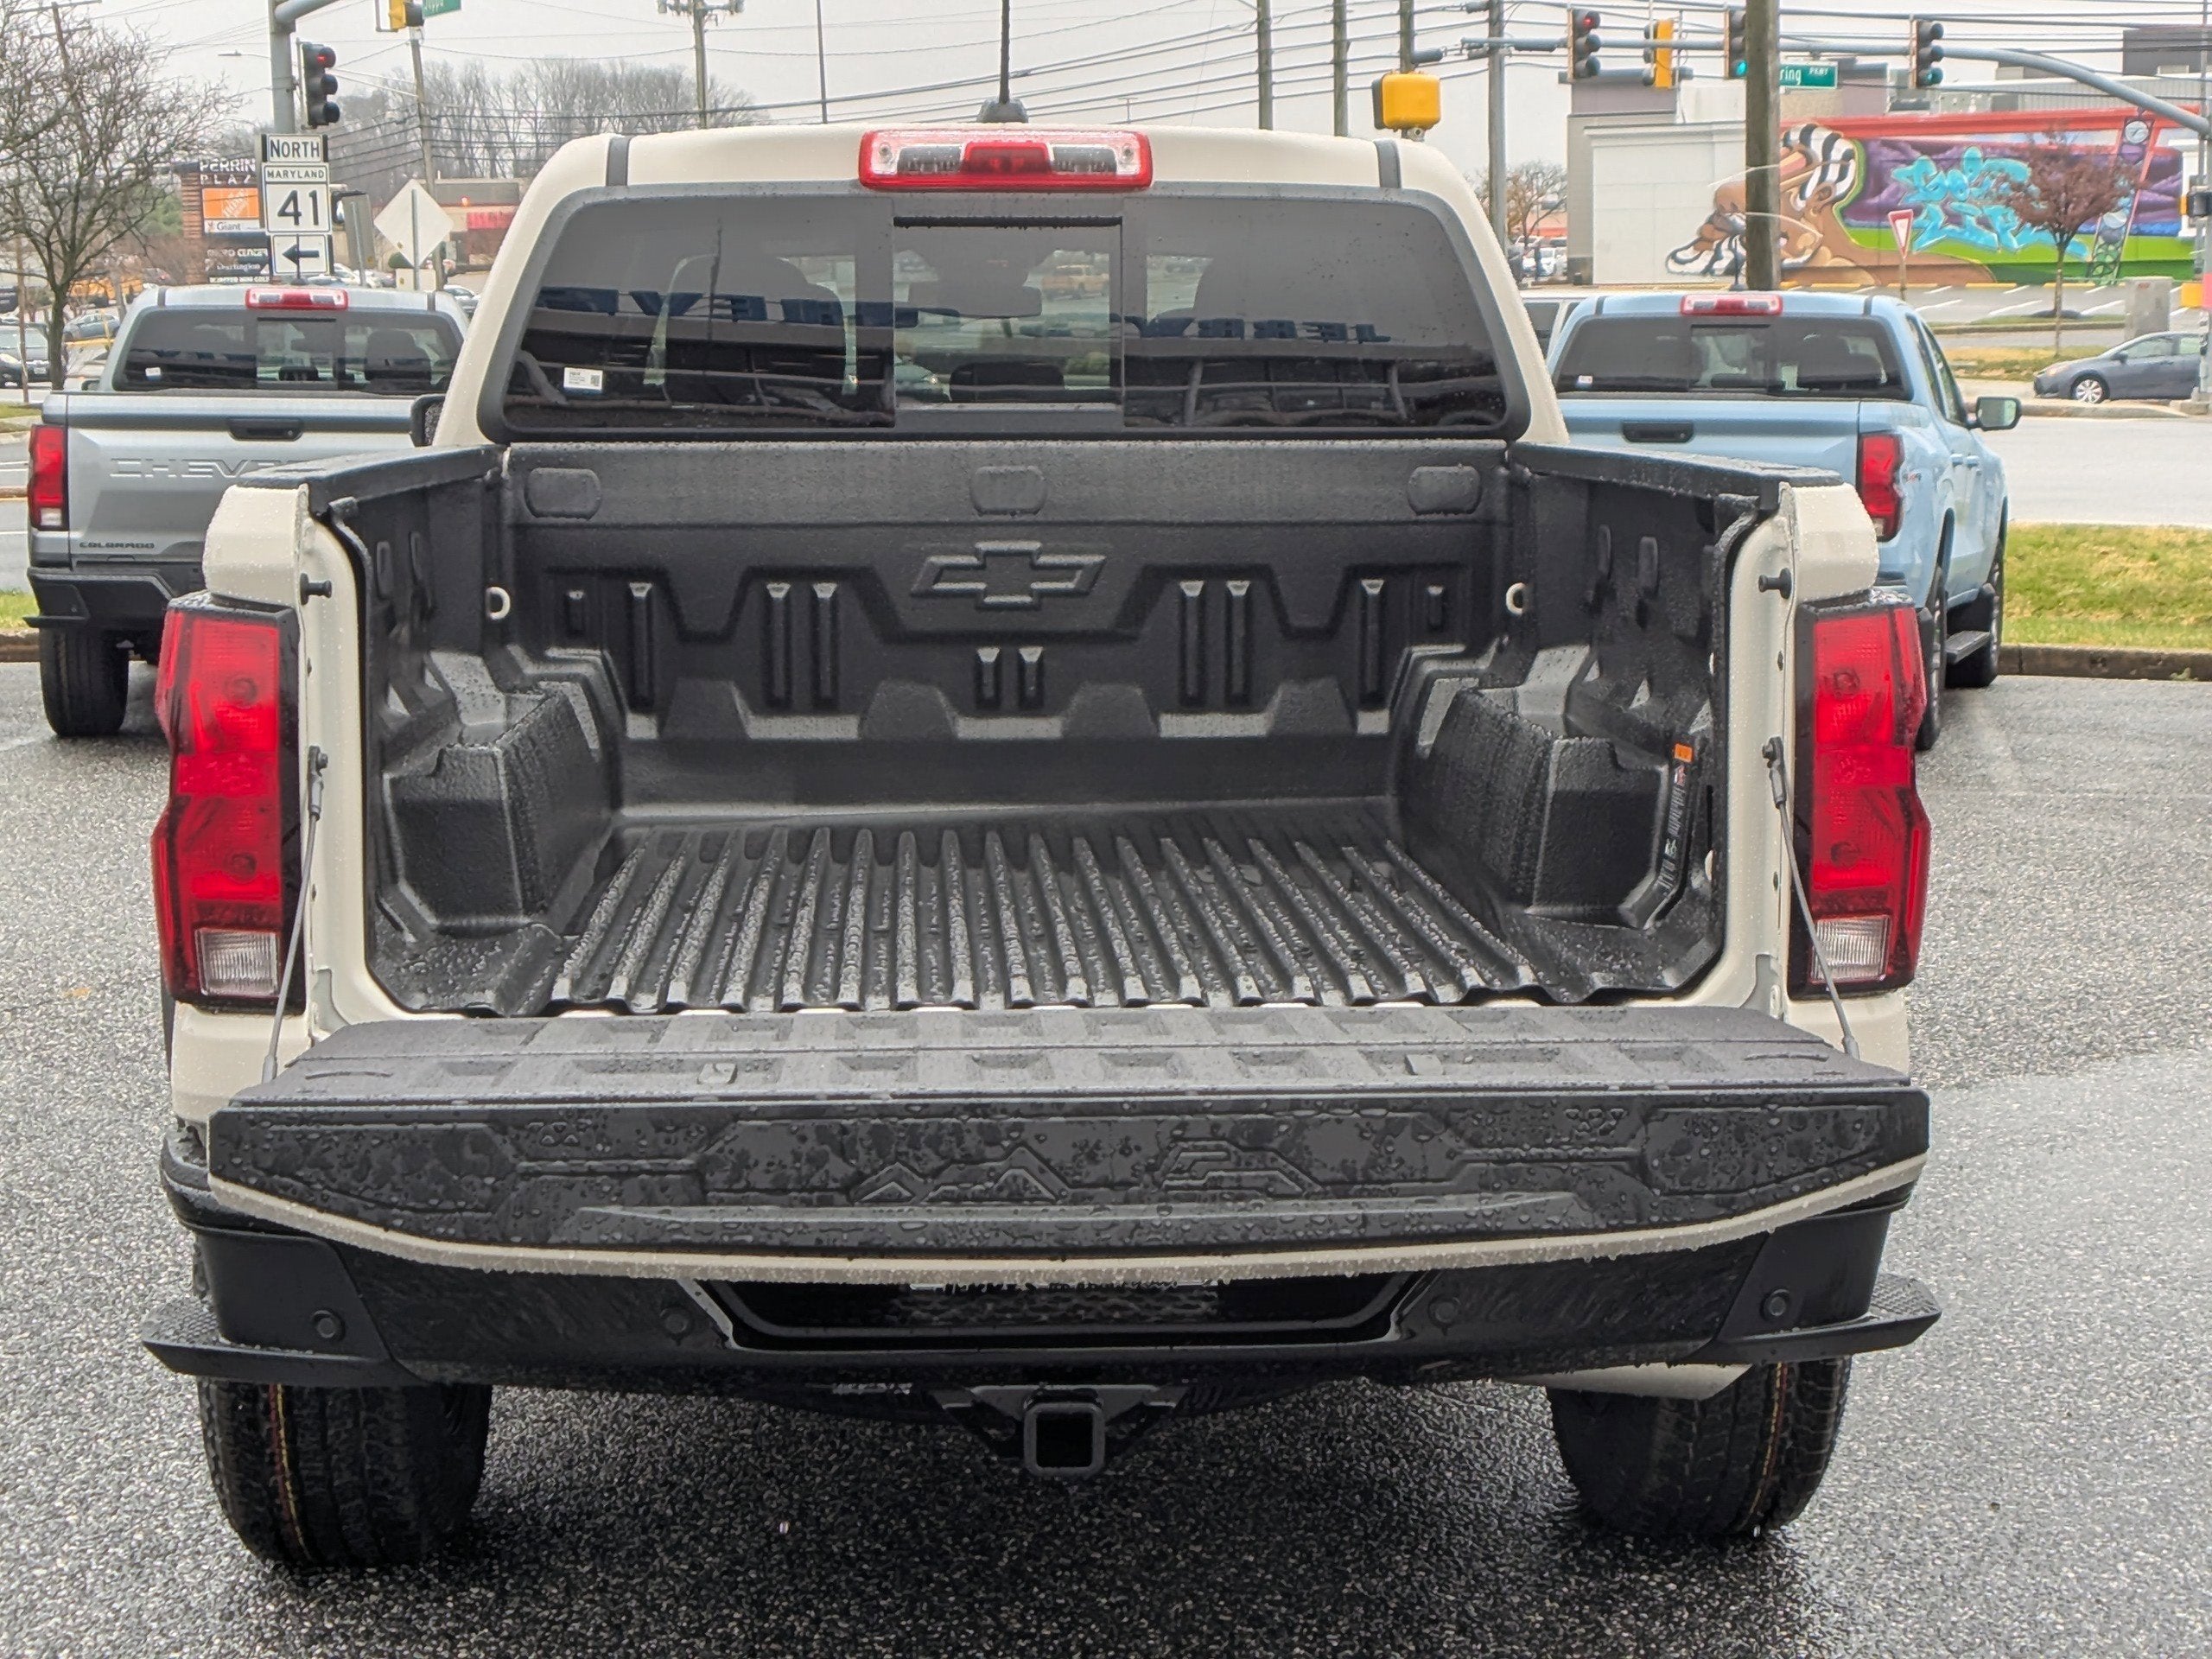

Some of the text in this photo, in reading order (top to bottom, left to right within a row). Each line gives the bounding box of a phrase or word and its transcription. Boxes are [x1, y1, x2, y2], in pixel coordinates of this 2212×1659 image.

[1780, 66, 1802, 86] ring
[270, 139, 321, 158] NORTH
[199, 158, 256, 172] PERRIN
[200, 174, 251, 185] PLAZ
[266, 169, 325, 179] MARYLAND
[276, 189, 320, 226] 41
[216, 221, 241, 232] Giant
[79, 541, 155, 550] COLORADO
